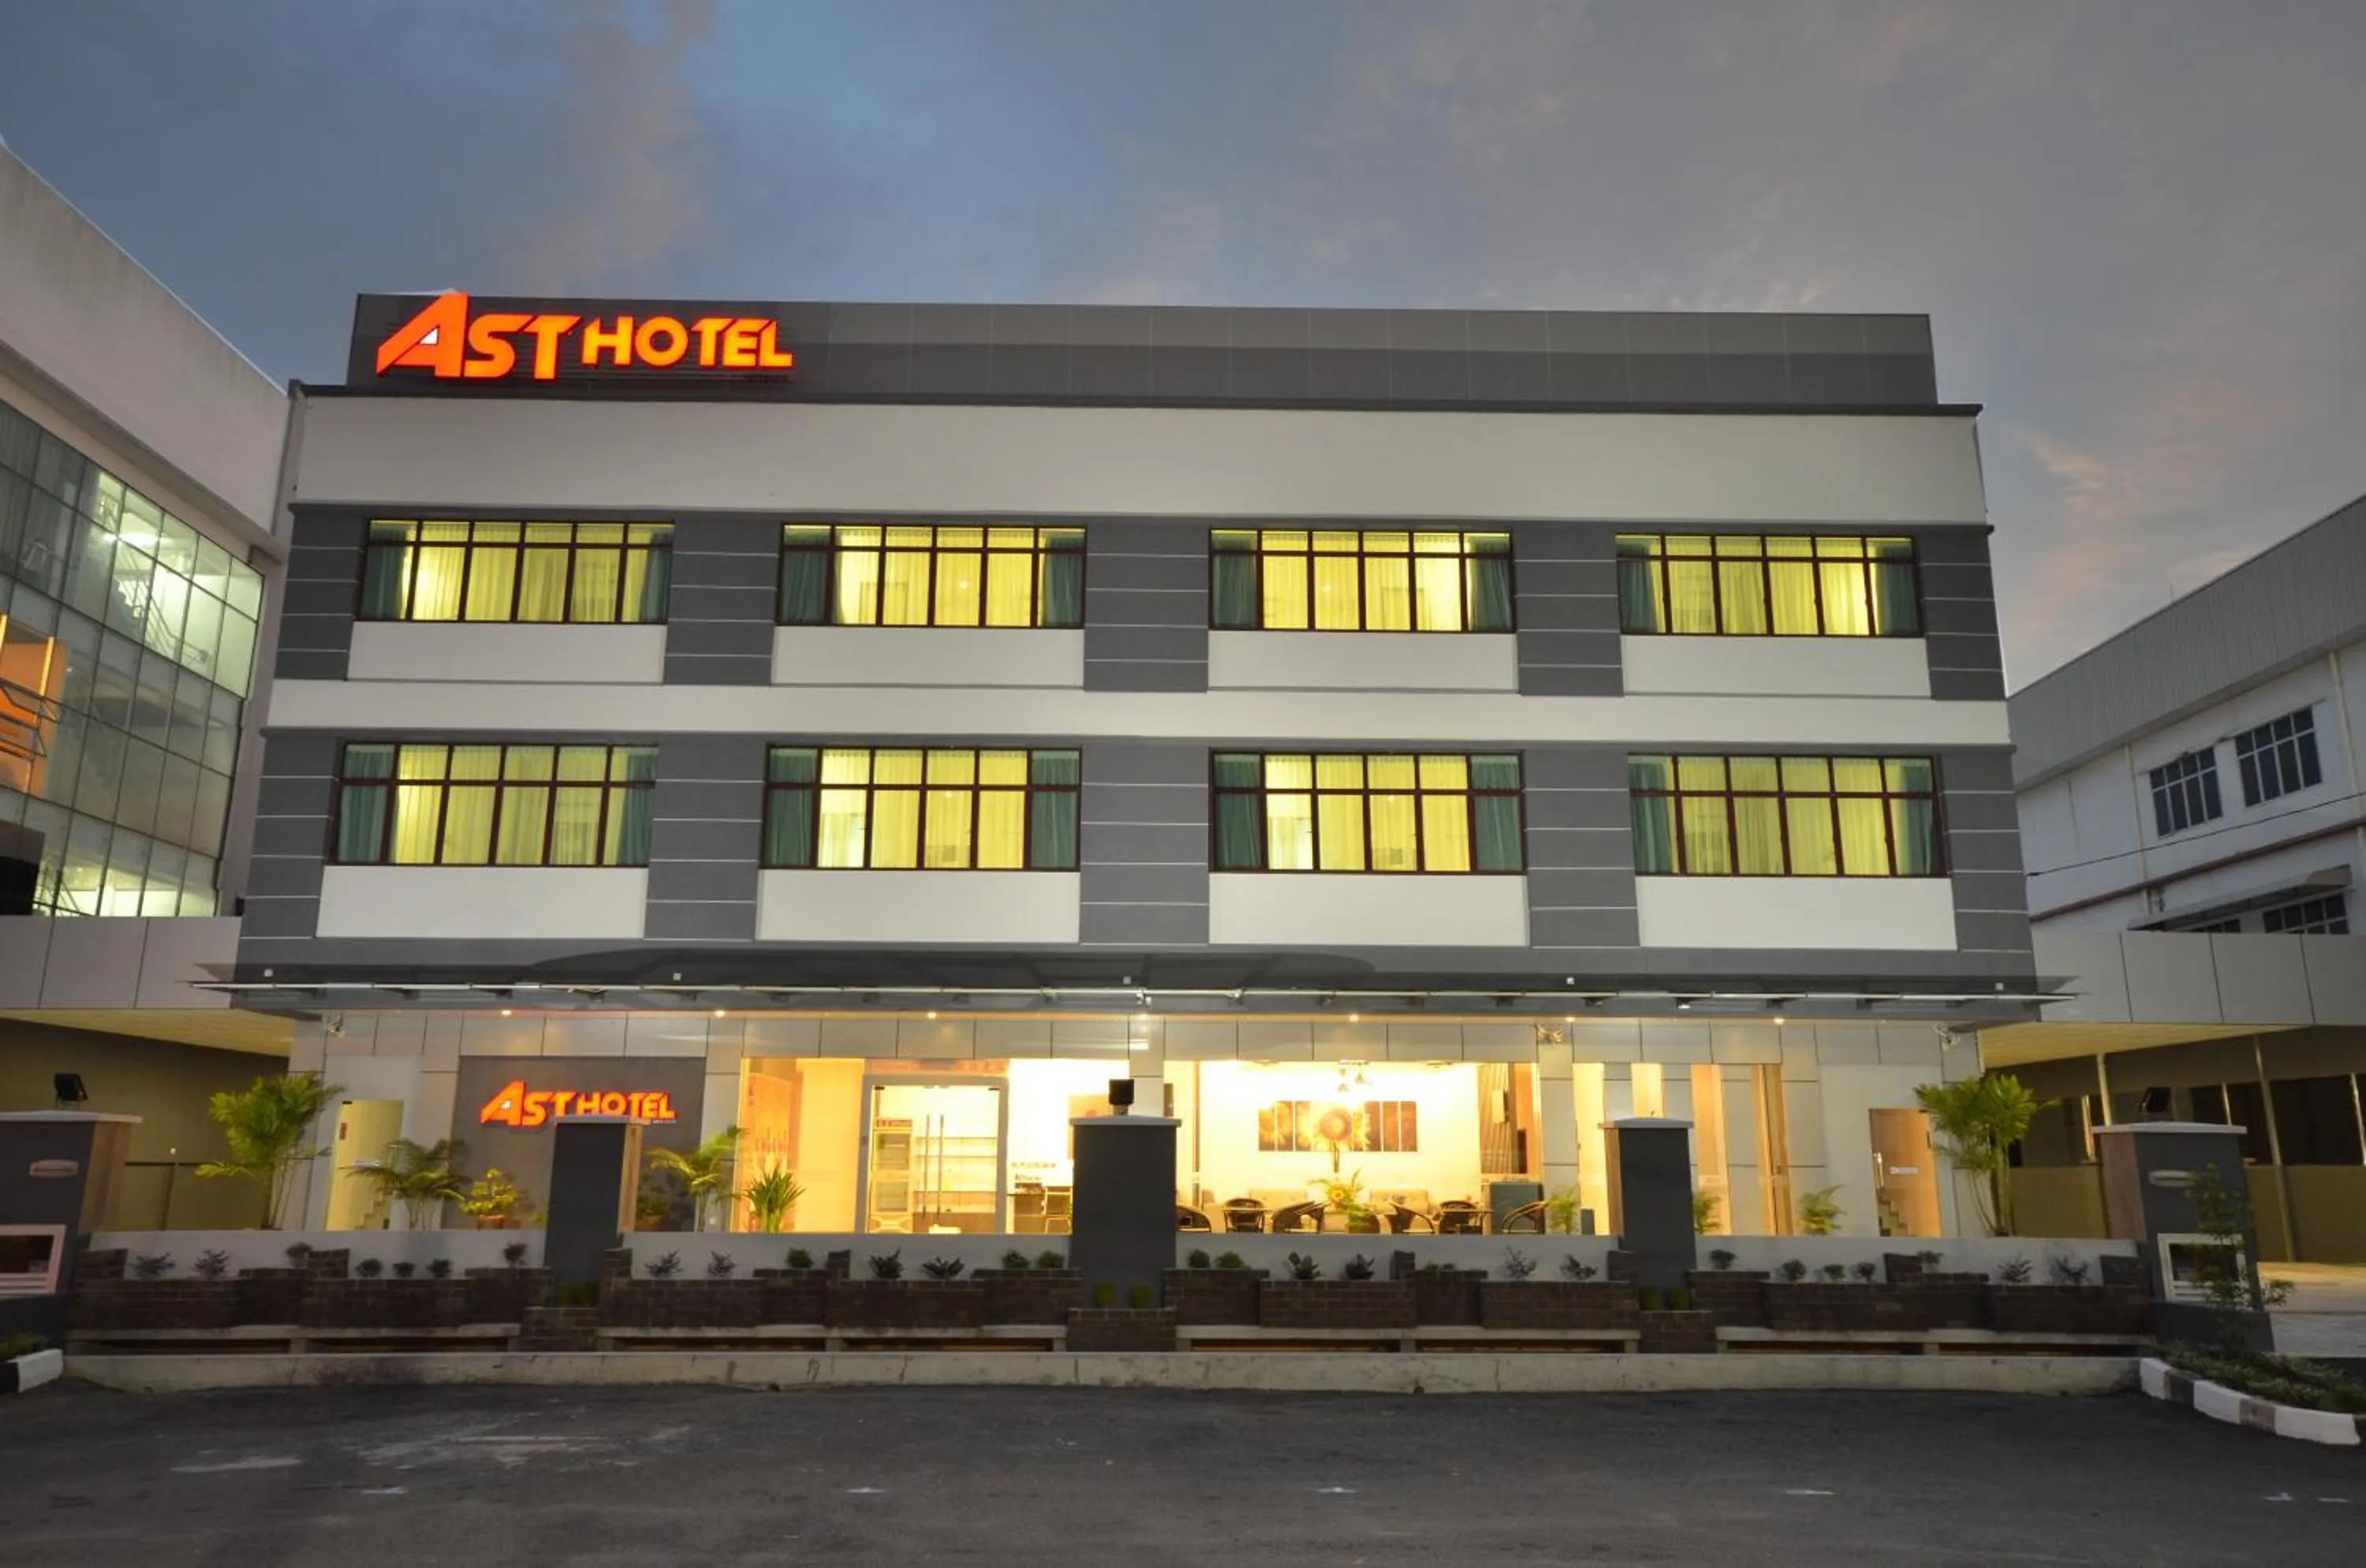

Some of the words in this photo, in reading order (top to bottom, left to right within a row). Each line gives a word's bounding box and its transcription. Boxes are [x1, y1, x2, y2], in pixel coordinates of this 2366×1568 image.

[375, 292, 583, 380] AST
[581, 316, 793, 368] HOTEL
[480, 1079, 577, 1126] AST
[575, 1092, 676, 1119] HOTEL
